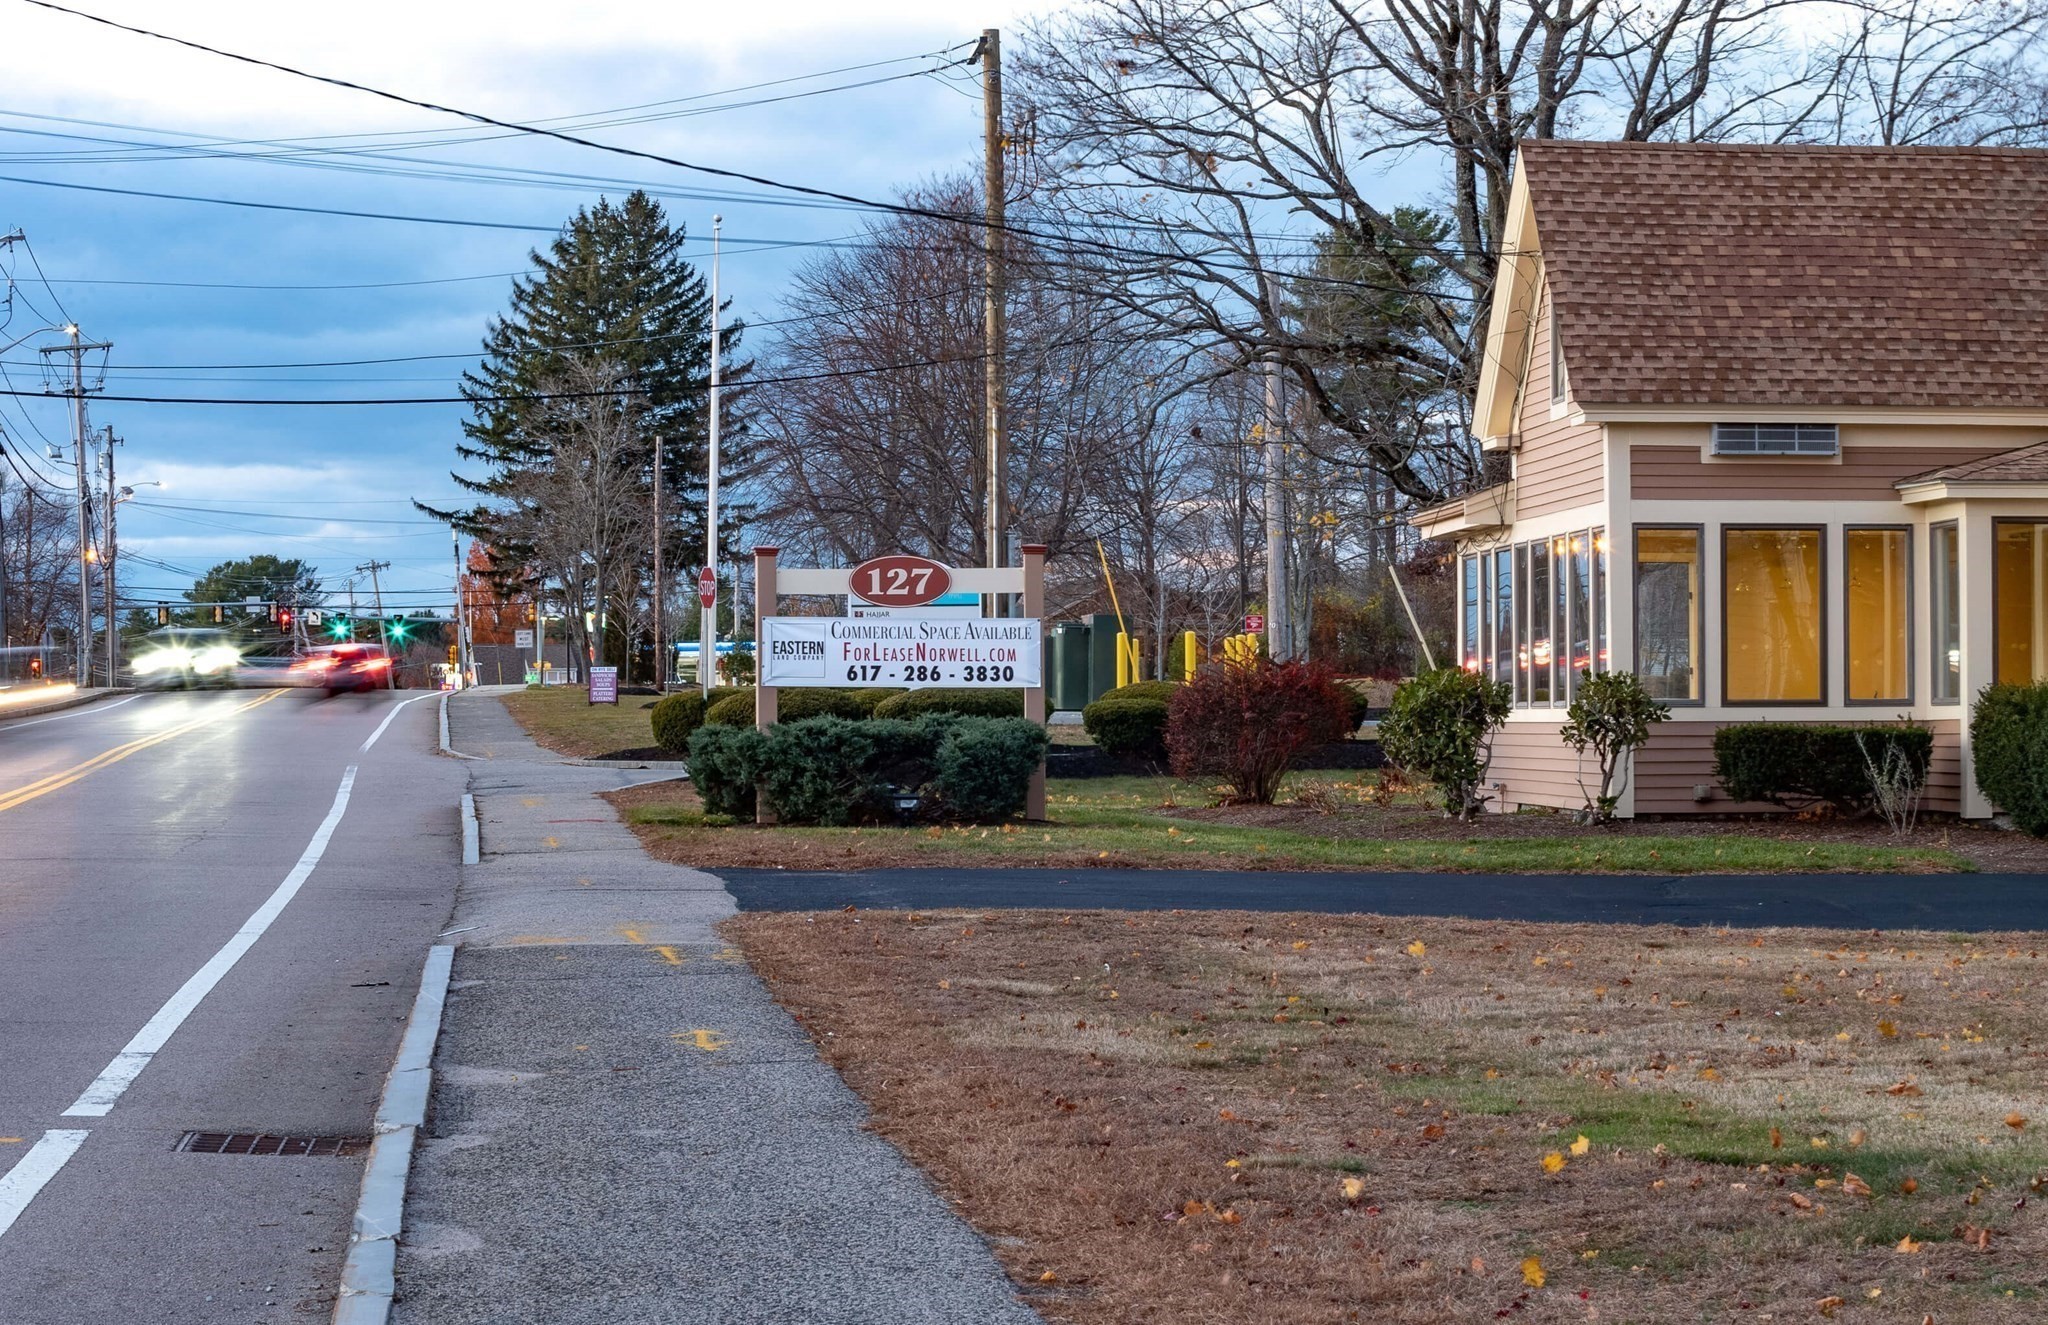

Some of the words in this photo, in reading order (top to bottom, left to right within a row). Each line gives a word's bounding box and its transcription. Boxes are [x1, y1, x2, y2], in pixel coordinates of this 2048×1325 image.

[700, 580, 715, 596] STOP
[867, 568, 934, 595] 127
[831, 621, 916, 640] COMMERCIAL
[919, 621, 961, 640] SPACE
[964, 621, 1032, 640] AVAILABLE
[772, 640, 824, 655] EASTERN
[847, 665, 882, 682] 617
[903, 665, 941, 682] 286
[963, 665, 1014, 682] 3830
